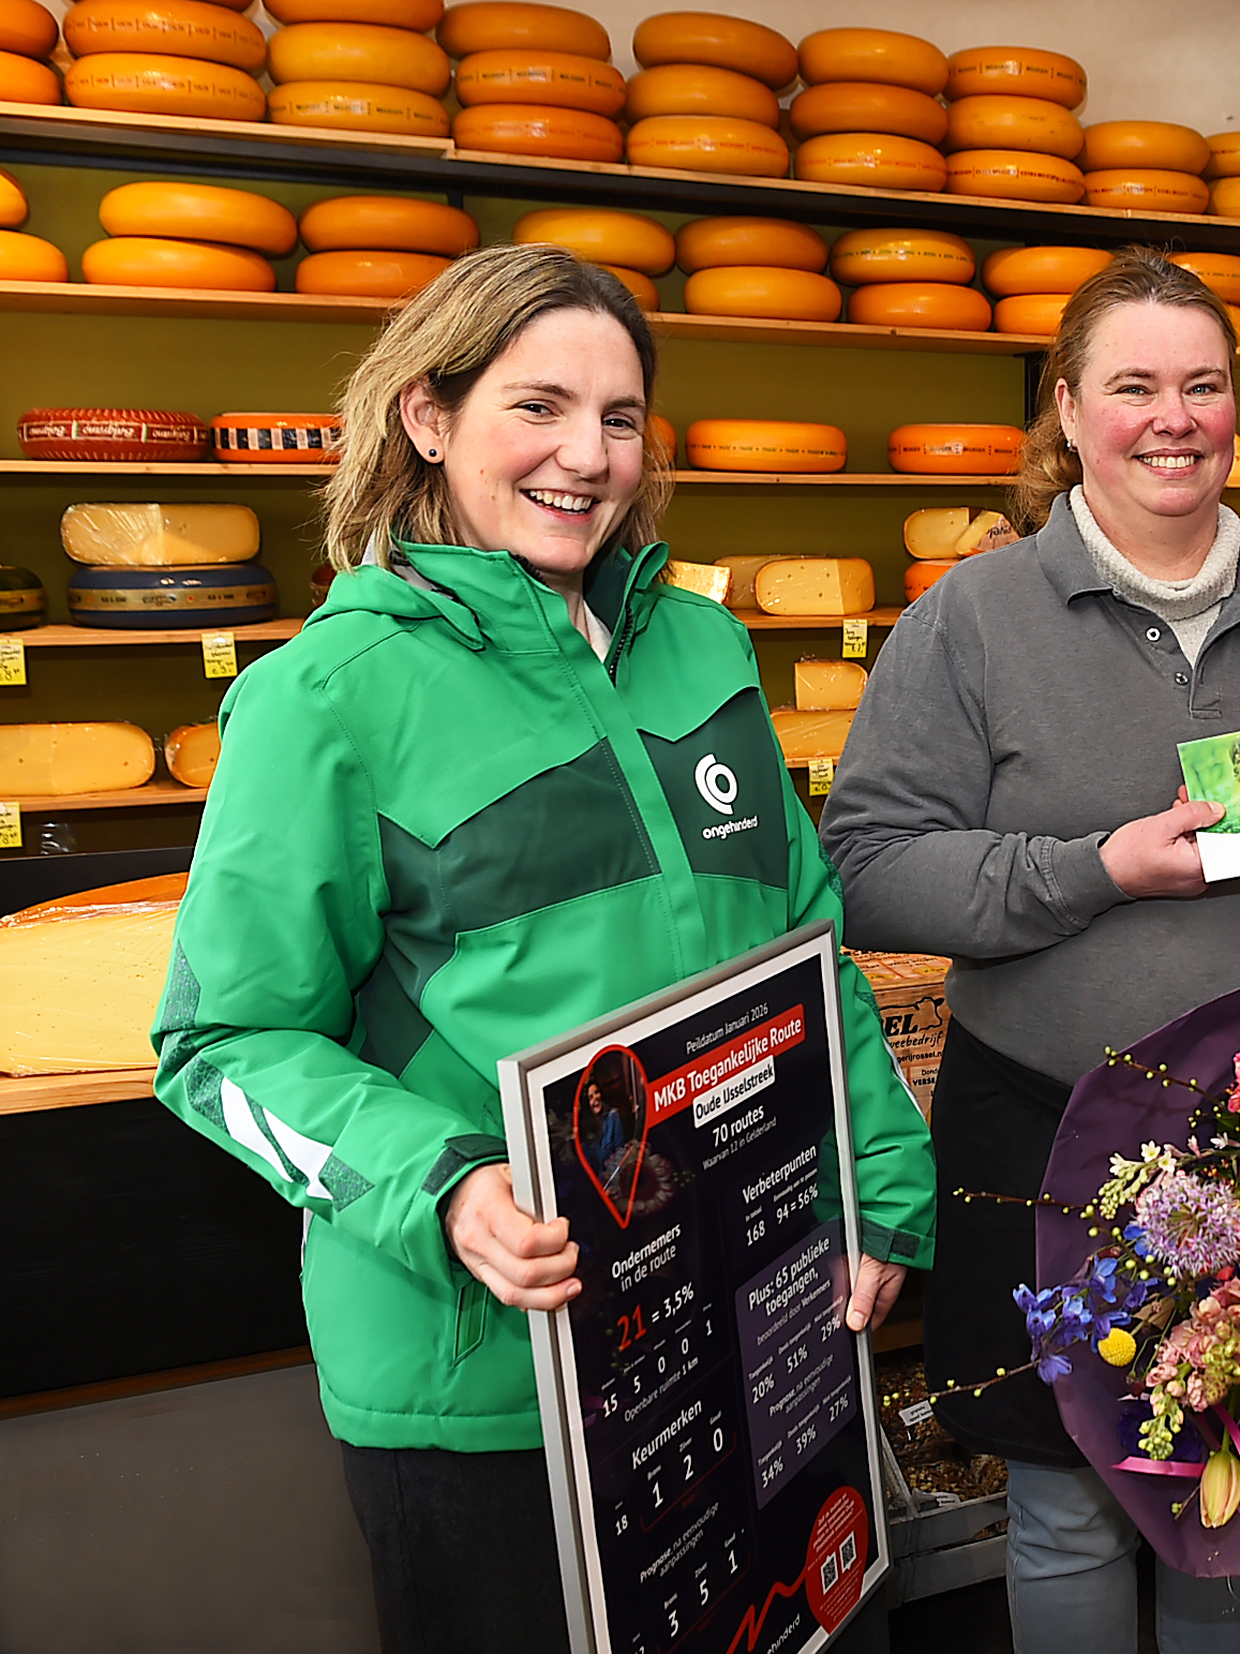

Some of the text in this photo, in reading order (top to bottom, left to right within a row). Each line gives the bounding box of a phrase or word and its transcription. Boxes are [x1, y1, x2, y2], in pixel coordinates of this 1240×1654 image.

[702, 815, 758, 840] ongehinderd
[686, 1002, 769, 1055] Peildatum Januari 2026
[654, 1018, 802, 1112] MKB Toegankelijke Route
[695, 1095, 722, 1120] Oude
[712, 1105, 764, 1148] 70 routes
[702, 1146, 730, 1171] Waarvan
[745, 1116, 777, 1144] Gelderland
[742, 1145, 817, 1205] Verbeterpunten
[746, 1219, 766, 1247] 168
[776, 1203, 790, 1225] 94
[797, 1182, 819, 1210] 56%
[611, 1223, 682, 1280] Ondernemers
[620, 1244, 677, 1293] in de route
[748, 1237, 830, 1311] Plus: 65 publieke
[617, 1303, 647, 1352] 21
[663, 1281, 695, 1319] 3,5%
[757, 1279, 832, 1346] beoordeeld door Verkenners
[765, 1266, 819, 1317] toegangen,
[603, 1392, 619, 1419] 15
[633, 1375, 642, 1394] 5
[657, 1355, 666, 1374] 0
[681, 1337, 690, 1356] 0
[705, 1319, 713, 1336] 1
[623, 1387, 659, 1423] Openbare
[659, 1368, 682, 1395] ruimte
[687, 1356, 699, 1372] km
[752, 1313, 841, 1405] 20% 51% 29%
[631, 1399, 703, 1471] Keurmerken
[761, 1393, 849, 1489] 34% 39% 27%
[615, 1427, 724, 1537] 18 1 2 0
[668, 1549, 739, 1638] 3 5 1
